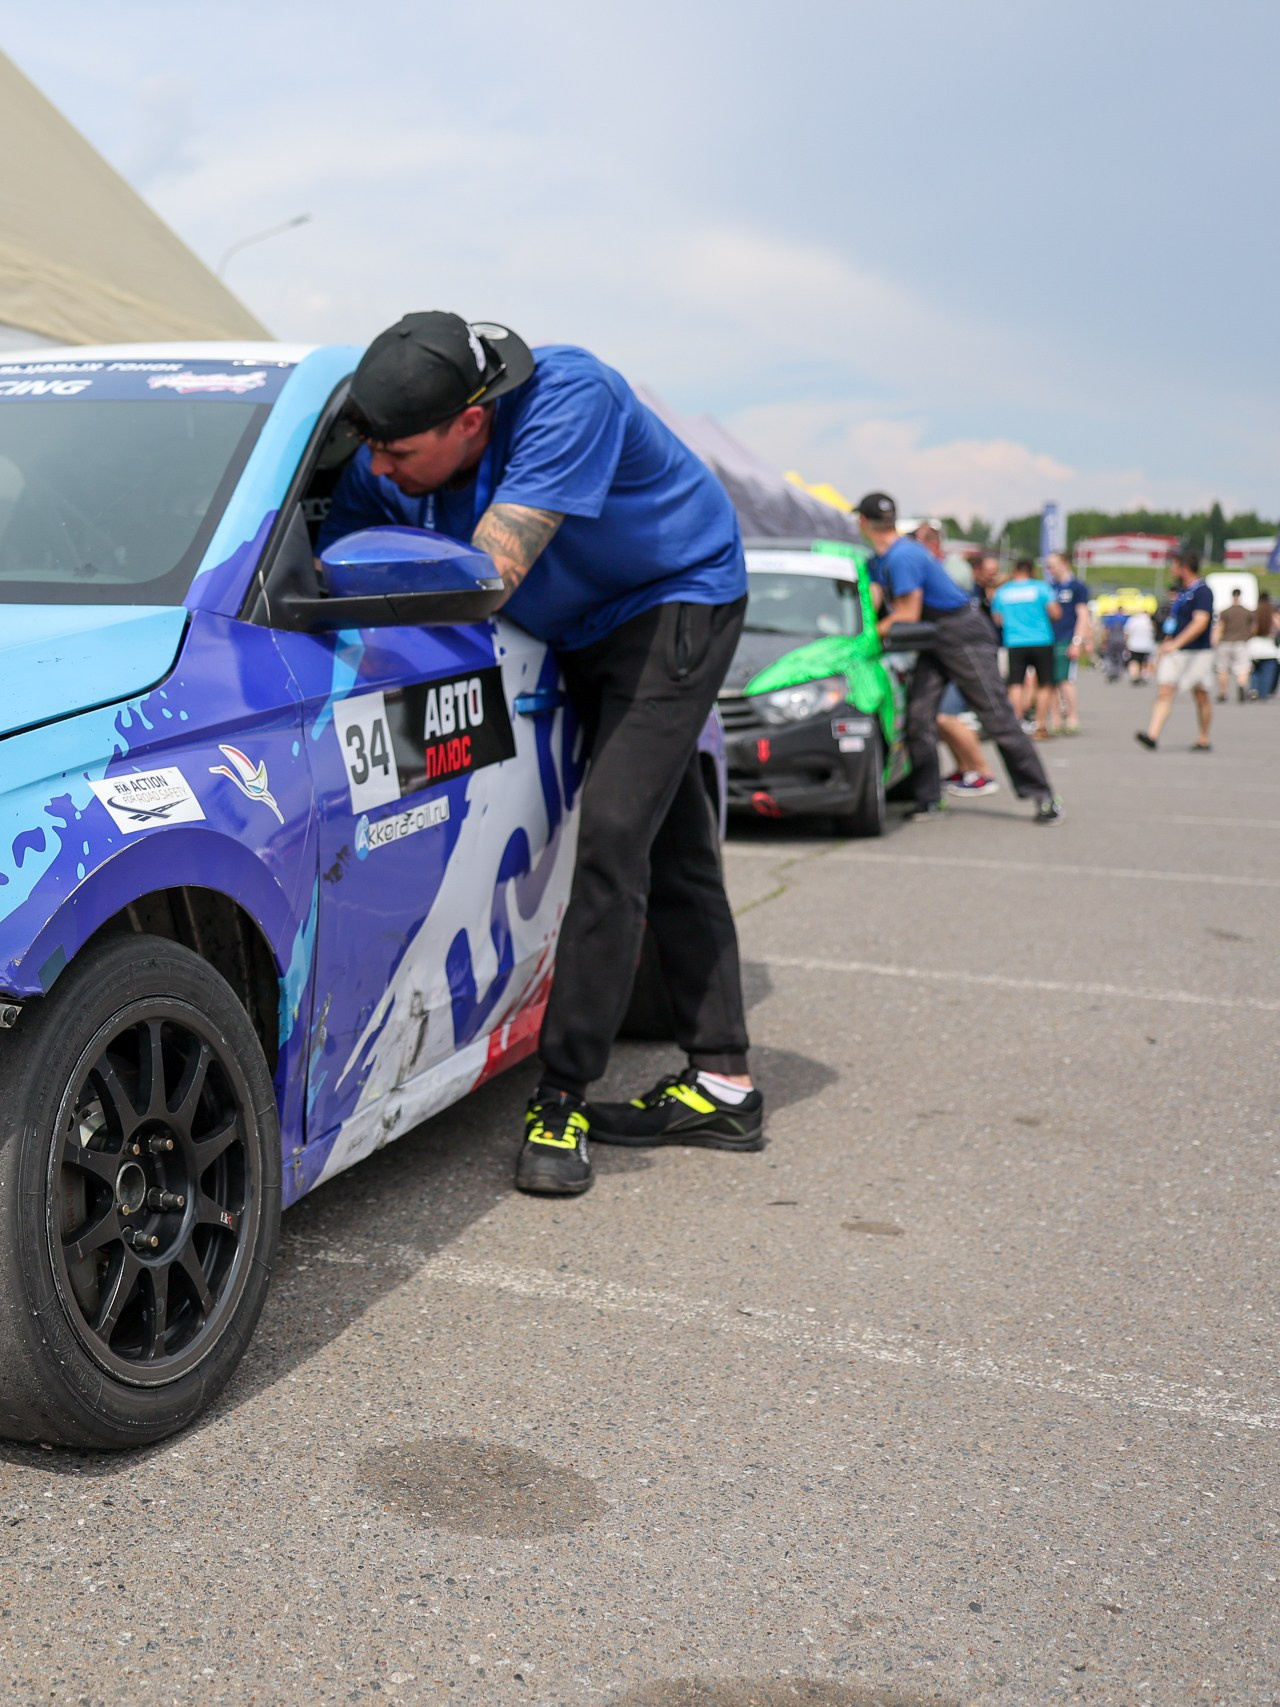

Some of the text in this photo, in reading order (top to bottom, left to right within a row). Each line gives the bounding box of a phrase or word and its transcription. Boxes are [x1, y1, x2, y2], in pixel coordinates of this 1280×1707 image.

[424, 677, 484, 741] АВТО
[346, 718, 390, 785] 34
[425, 735, 472, 779] ПЛЮС
[122, 785, 188, 805] FOR ROAD SAFETY
[129, 774, 169, 793] ACTION
